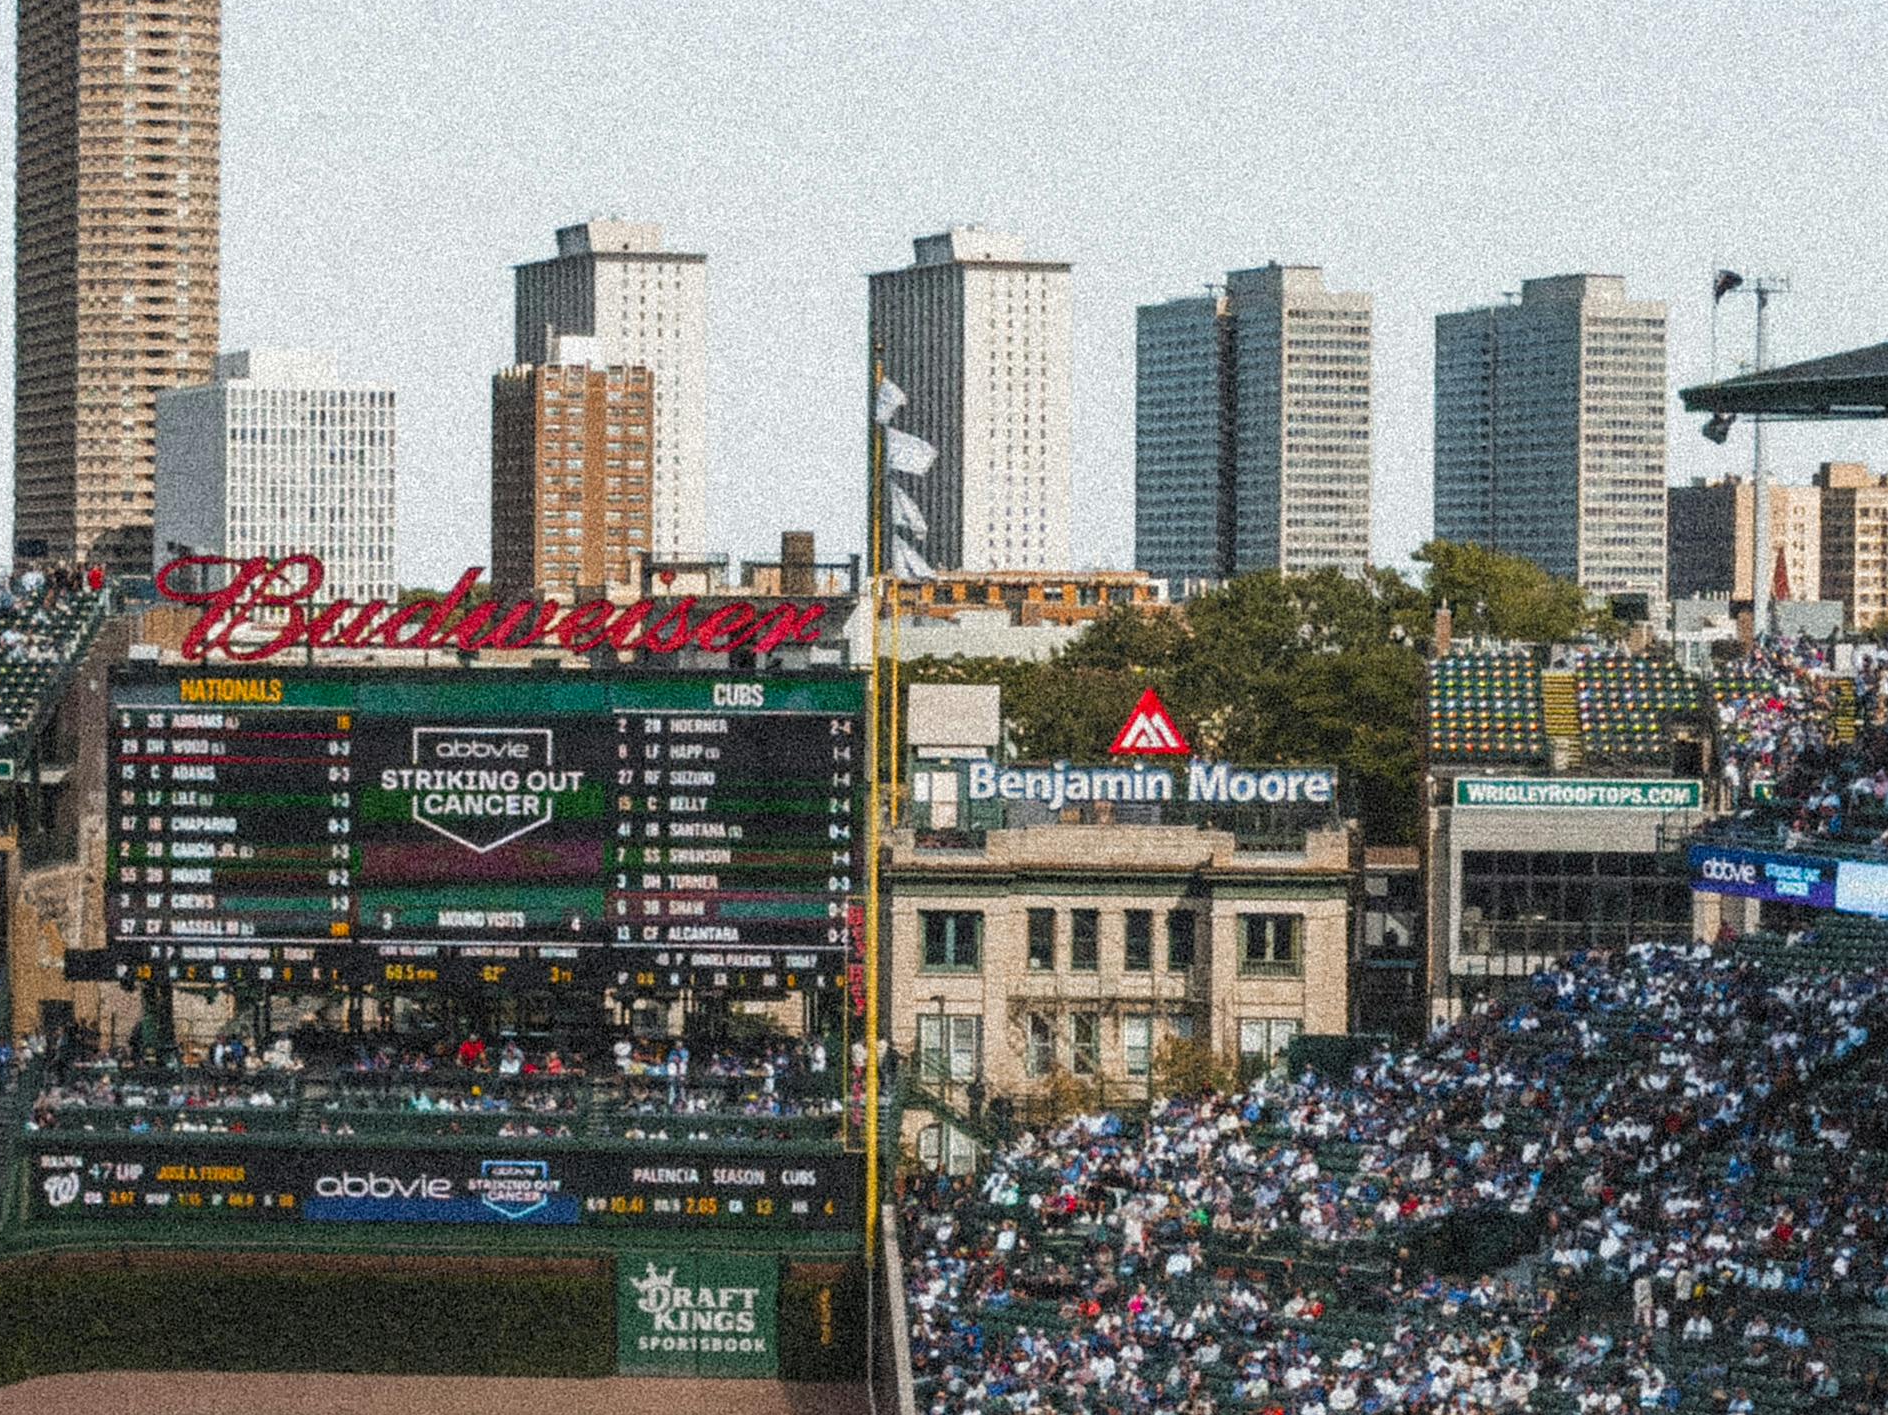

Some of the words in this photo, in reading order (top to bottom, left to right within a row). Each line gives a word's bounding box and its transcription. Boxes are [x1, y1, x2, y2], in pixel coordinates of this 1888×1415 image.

[156, 553, 824, 661] Budweiser
[180, 679, 284, 703] NATIONALS
[713, 683, 764, 707] CUBS
[171, 714, 223, 729] ABRAMS
[669, 718, 728, 733] HOERNER
[171, 739, 209, 754] WOOD
[435, 739, 530, 759] abbvie
[669, 744, 703, 759] HAPP
[171, 765, 216, 780] ADAMS
[381, 769, 519, 791] STRIKING
[526, 771, 584, 792] OUT
[969, 763, 1172, 809] Benjamin
[1188, 760, 1333, 803] Moore
[1466, 783, 1692, 805] WRIGLEYROOFTOPS.COM
[424, 794, 540, 815] CANCER
[669, 796, 708, 811] KELLY
[171, 816, 237, 831] CHAPARRO
[669, 823, 726, 838] SANTANA
[669, 848, 731, 863] SWANSON
[171, 868, 212, 883] HOUSE
[1701, 857, 1756, 884] abbvie
[668, 874, 718, 889] TURNER
[171, 894, 215, 909] CREWS
[668, 900, 705, 915] SHAW
[487, 912, 525, 928] VISITS
[632, 1167, 701, 1184] PALENCIA
[712, 1168, 766, 1185] SEASON
[781, 1169, 817, 1187] CUBS
[315, 1172, 453, 1200] abbvie
[488, 1190, 542, 1202] CANCER
[636, 1284, 760, 1313] DRAFT
[653, 1310, 756, 1332] KINGS
[637, 1336, 766, 1353] SPORTSBOOK
